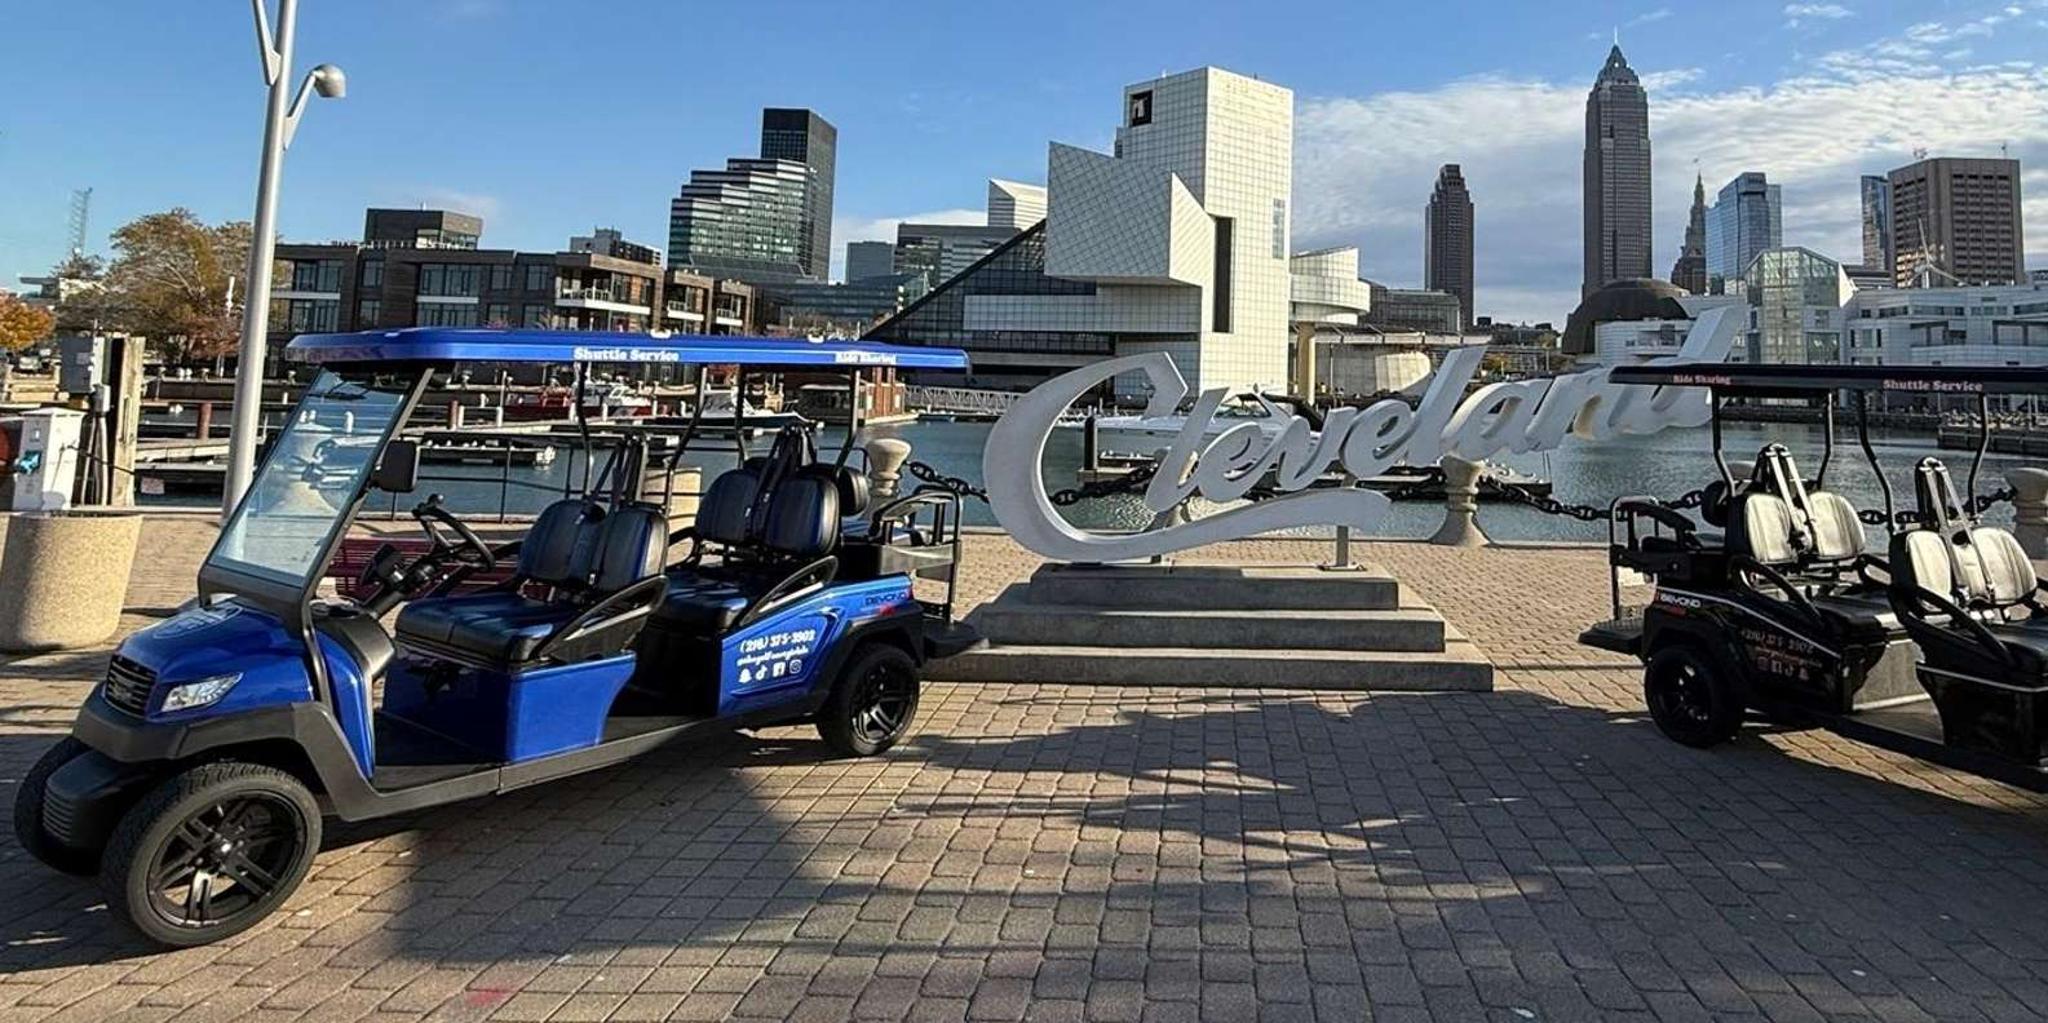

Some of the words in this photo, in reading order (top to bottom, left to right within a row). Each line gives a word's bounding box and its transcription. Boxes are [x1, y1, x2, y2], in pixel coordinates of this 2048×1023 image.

[574, 347, 627, 361] Shuttle
[630, 349, 680, 362] Service
[1673, 374, 1693, 384] Ride
[1695, 375, 1731, 385] Sharing
[1883, 379, 1930, 390] Shuttle
[1933, 380, 1983, 392] Service
[983, 305, 1742, 562] Cleveland
